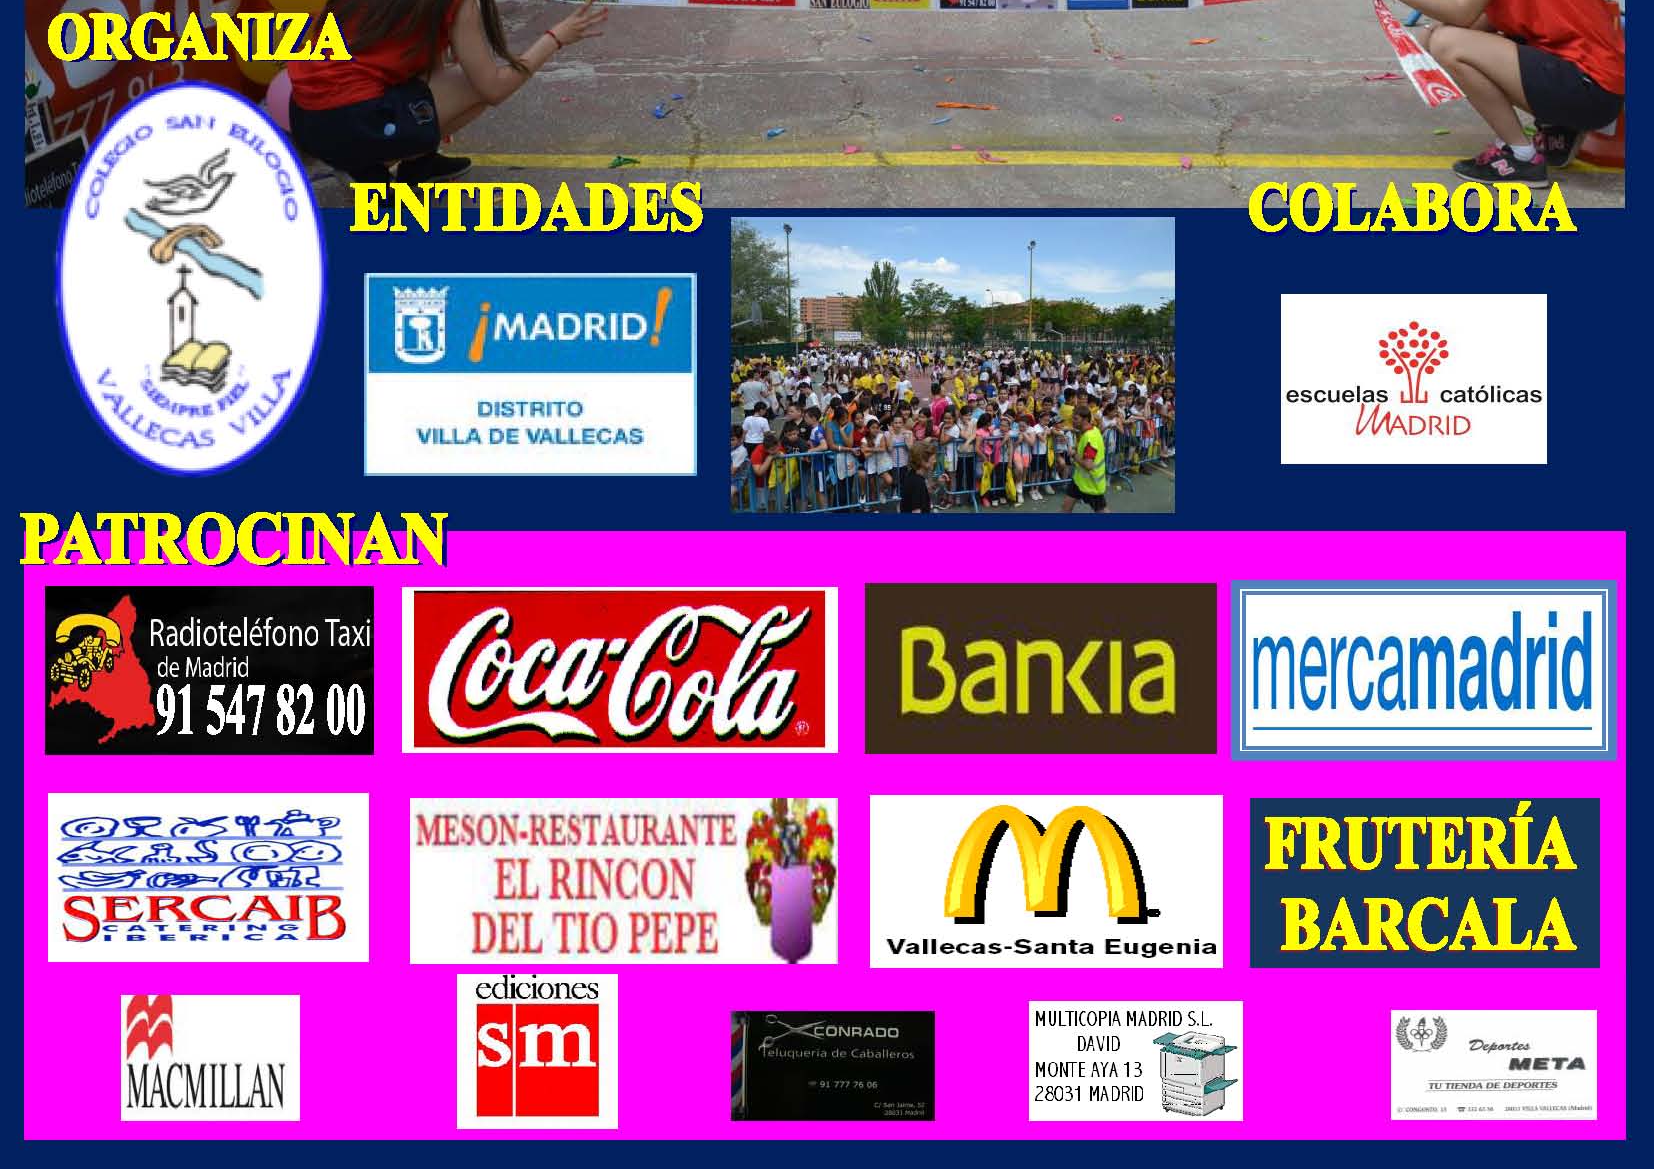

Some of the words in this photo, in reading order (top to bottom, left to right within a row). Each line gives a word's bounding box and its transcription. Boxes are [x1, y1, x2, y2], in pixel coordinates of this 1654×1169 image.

[86, 125, 153, 220] COLEGIO
[165, 115, 216, 131] SAN
[228, 123, 299, 222] EULOGIO
[468, 286, 673, 363] ¡MADRID!
[1287, 386, 1388, 405] escuelas
[1441, 385, 1542, 403] católicas
[95, 367, 216, 450] VALLECAS
[228, 367, 293, 436] VILLA
[479, 400, 583, 417] DISTRITO
[1356, 403, 1471, 435] MADRID
[419, 430, 480, 445] VILLA
[489, 428, 517, 445] DE
[528, 429, 644, 445] VALLECAS
[21, 512, 447, 564] PATROCINAN
[151, 617, 318, 646] Radioteléfono
[325, 619, 370, 646] Taxi
[158, 656, 179, 677] de
[186, 656, 248, 677] Madrid
[428, 604, 811, 742] Coca-Cola
[902, 627, 1175, 714] Bankia
[1253, 611, 1592, 711] mercamadrid
[157, 684, 193, 735] 91
[207, 684, 265, 735] 547
[277, 684, 314, 735] 82
[327, 684, 365, 735] 00
[418, 814, 736, 846] MESON-RESTAURANTE
[1265, 802, 1575, 870] FRUTERÍA
[495, 858, 540, 900] EL
[549, 858, 694, 900] RINCON
[62, 895, 347, 943] SERCAIB
[102, 924, 300, 932] CATERING
[1281, 898, 1576, 951] BARCALA
[103, 934, 299, 942] IBERICA
[472, 911, 543, 954] DEL
[552, 911, 617, 954] TIO
[629, 911, 718, 954] PEPE
[887, 939, 1093, 954] Vallecas-Santa
[1106, 939, 1216, 958] Eugenia
[476, 975, 598, 999] ediciones
[1036, 1011, 1121, 1026] MULTICOPIA
[1127, 1011, 1182, 1026] MADRID
[1188, 1011, 1212, 1026] S.L.
[477, 1021, 597, 1069] sm
[814, 1026, 900, 1039] CONRADO
[1078, 1036, 1120, 1051] DAVID
[831, 1049, 847, 1058] de
[850, 1049, 915, 1060] Caballeros
[1470, 1040, 1528, 1053] Deportes
[1036, 1062, 1085, 1077] MONTE
[1091, 1062, 1118, 1077] AYA
[1124, 1062, 1142, 1077] 13
[1509, 1058, 1584, 1070] META
[127, 1063, 284, 1108] MACMILLAN
[819, 1081, 831, 1089] 91
[833, 1081, 850, 1089] 777
[1035, 1086, 1080, 1101] 28031
[1090, 1086, 1143, 1101] MADRID
[1428, 1082, 1441, 1090] TU
[1445, 1082, 1482, 1090] TIENDA
[1486, 1082, 1499, 1090] DE
[1503, 1081, 1558, 1089] DEPORTES
